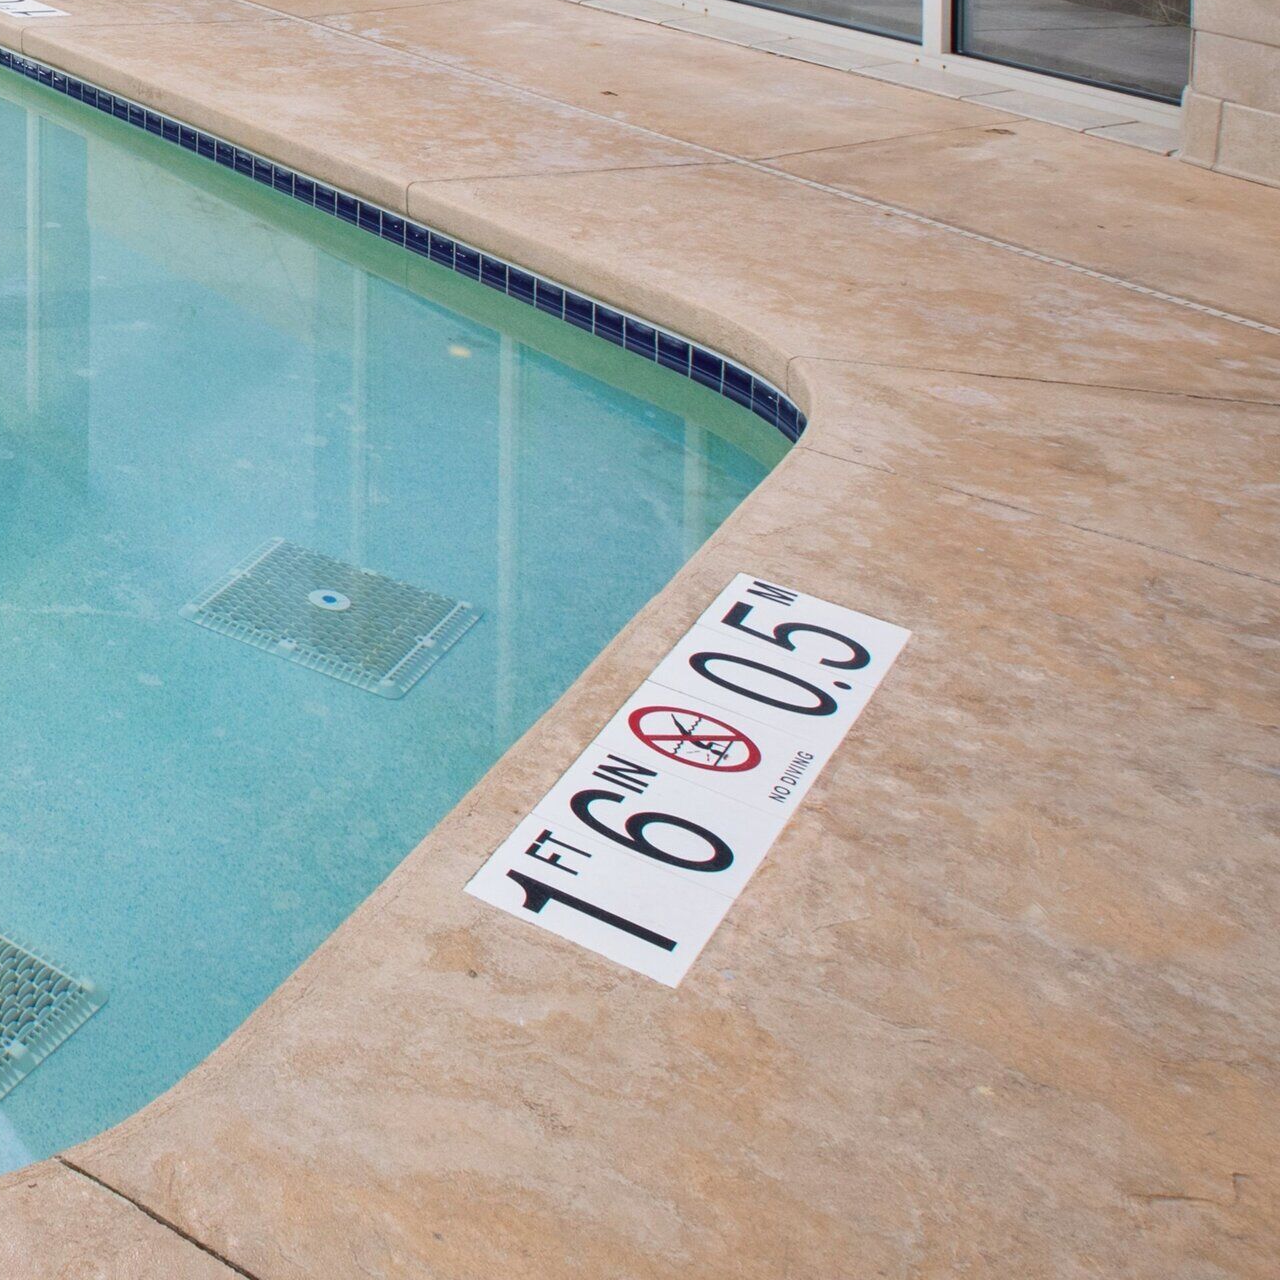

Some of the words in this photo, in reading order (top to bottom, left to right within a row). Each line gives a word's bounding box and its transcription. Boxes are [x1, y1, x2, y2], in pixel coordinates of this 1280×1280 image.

[747, 580, 798, 607] M
[592, 754, 658, 794] IN
[768, 785, 791, 803] NO
[780, 750, 814, 786] DIVING
[525, 829, 592, 875] FT
[570, 789, 734, 873] 6
[506, 869, 678, 952] 1
